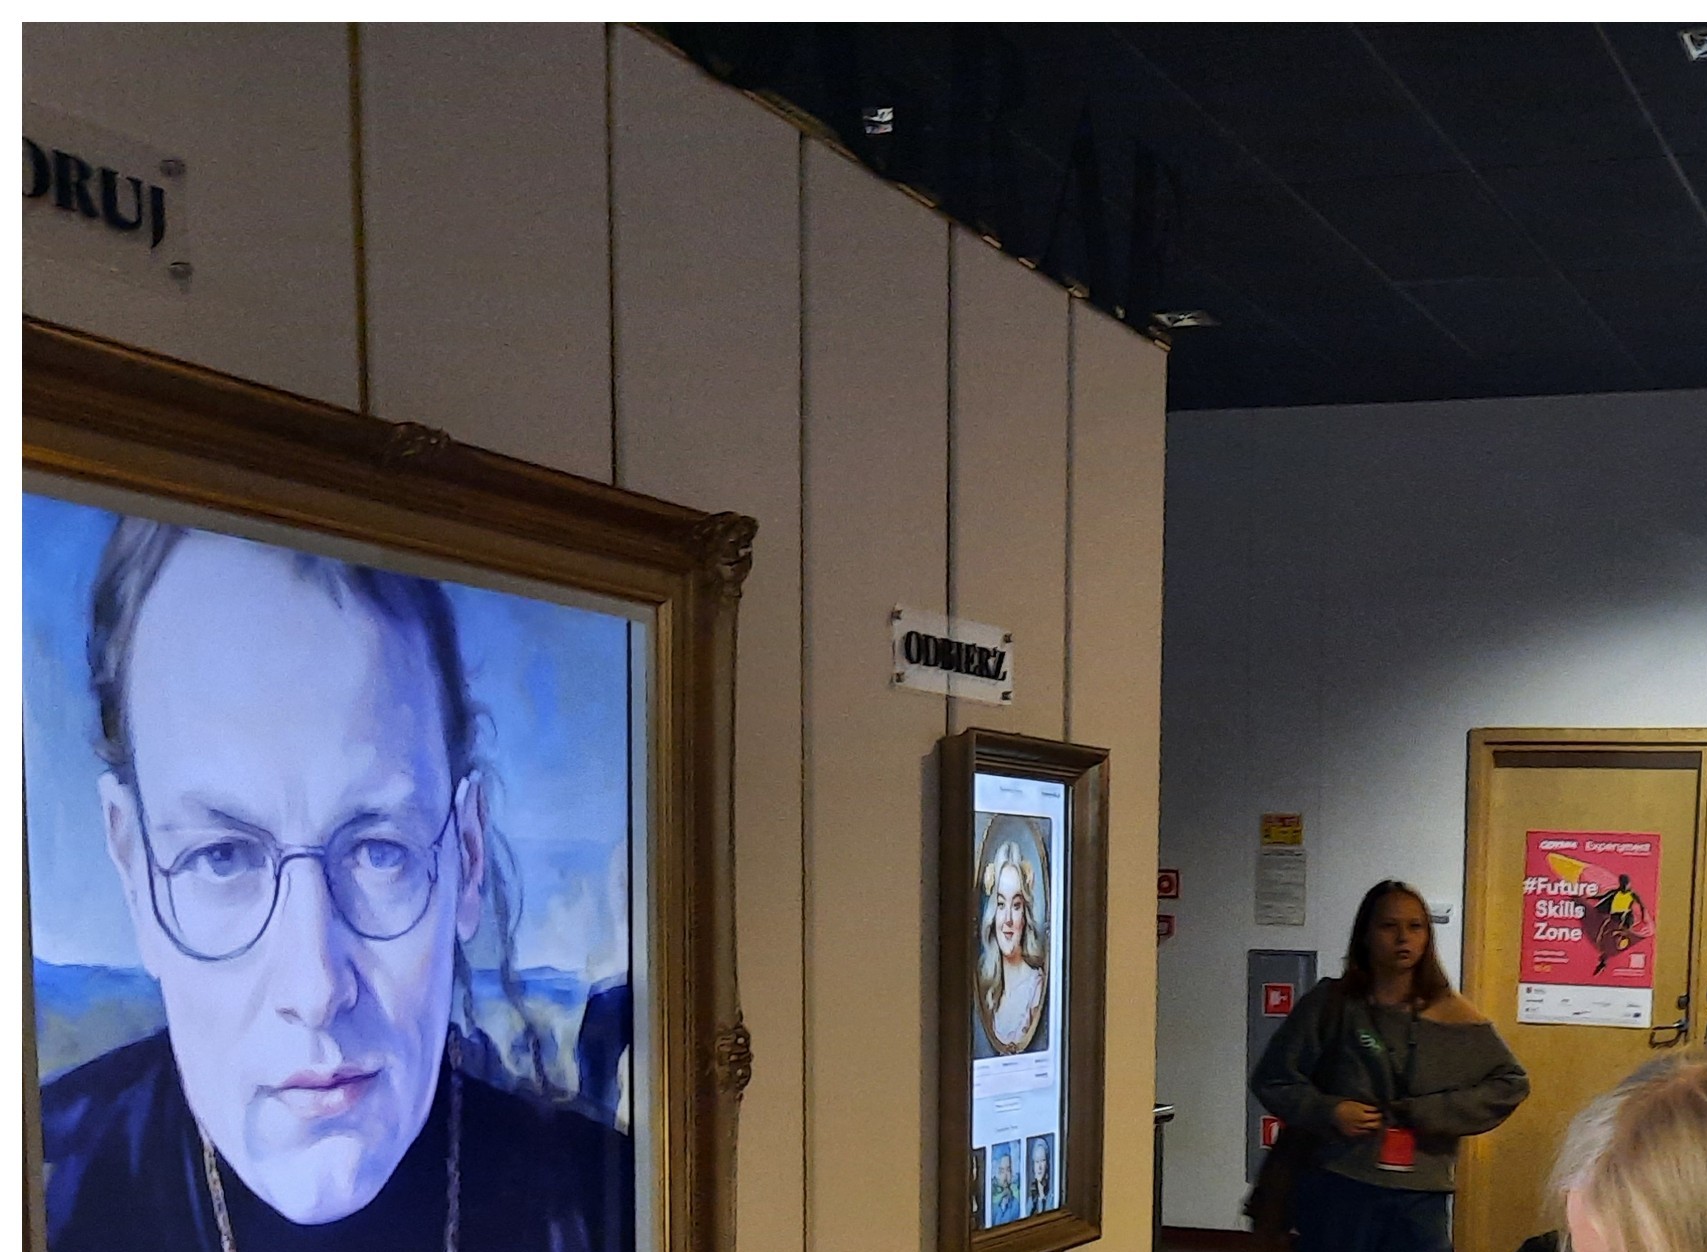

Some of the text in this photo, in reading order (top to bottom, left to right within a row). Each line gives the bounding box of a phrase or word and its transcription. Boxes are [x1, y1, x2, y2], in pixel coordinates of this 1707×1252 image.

[905, 631, 1008, 681] ODBIERZ
[1523, 877, 1599, 896] #Future
[1535, 900, 1586, 919] Skills
[1533, 922, 1583, 941] Zone
